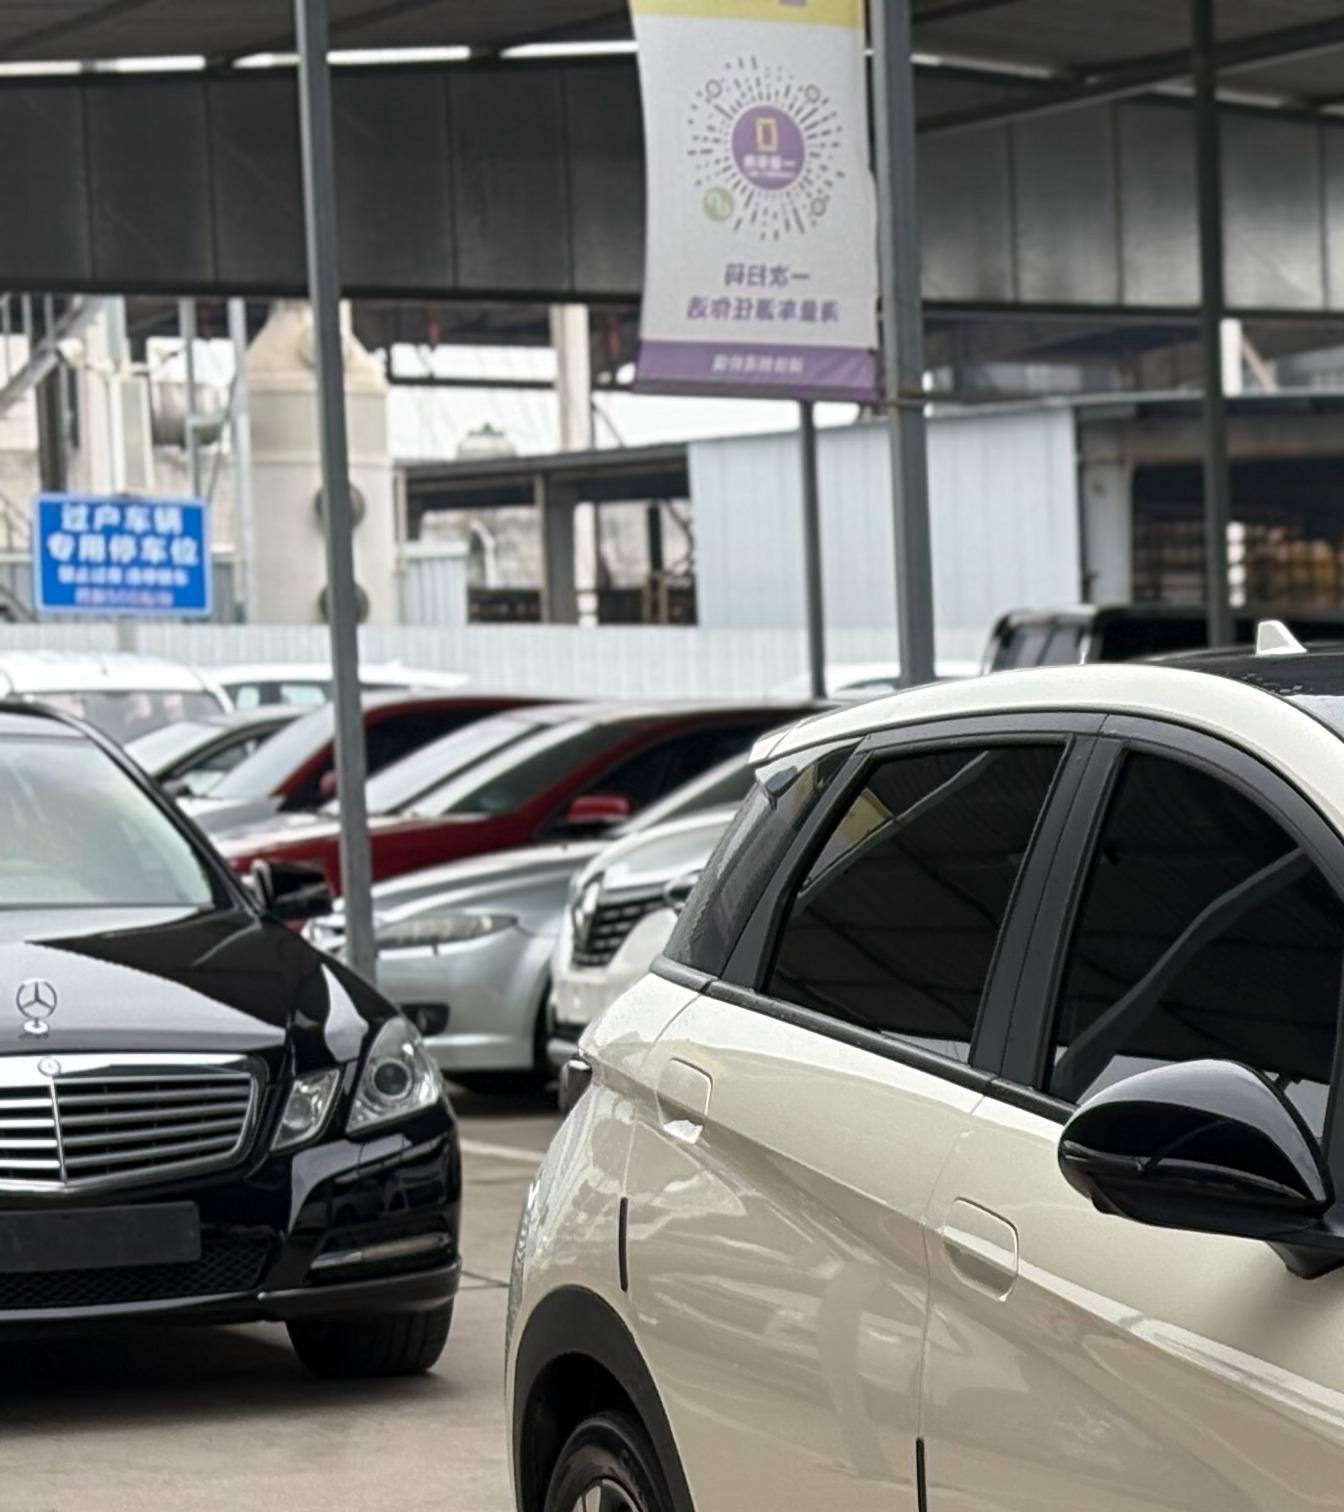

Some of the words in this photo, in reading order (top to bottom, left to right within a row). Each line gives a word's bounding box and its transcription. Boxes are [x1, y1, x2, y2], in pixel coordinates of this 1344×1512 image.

[47, 532, 199, 567] 专用停车位
